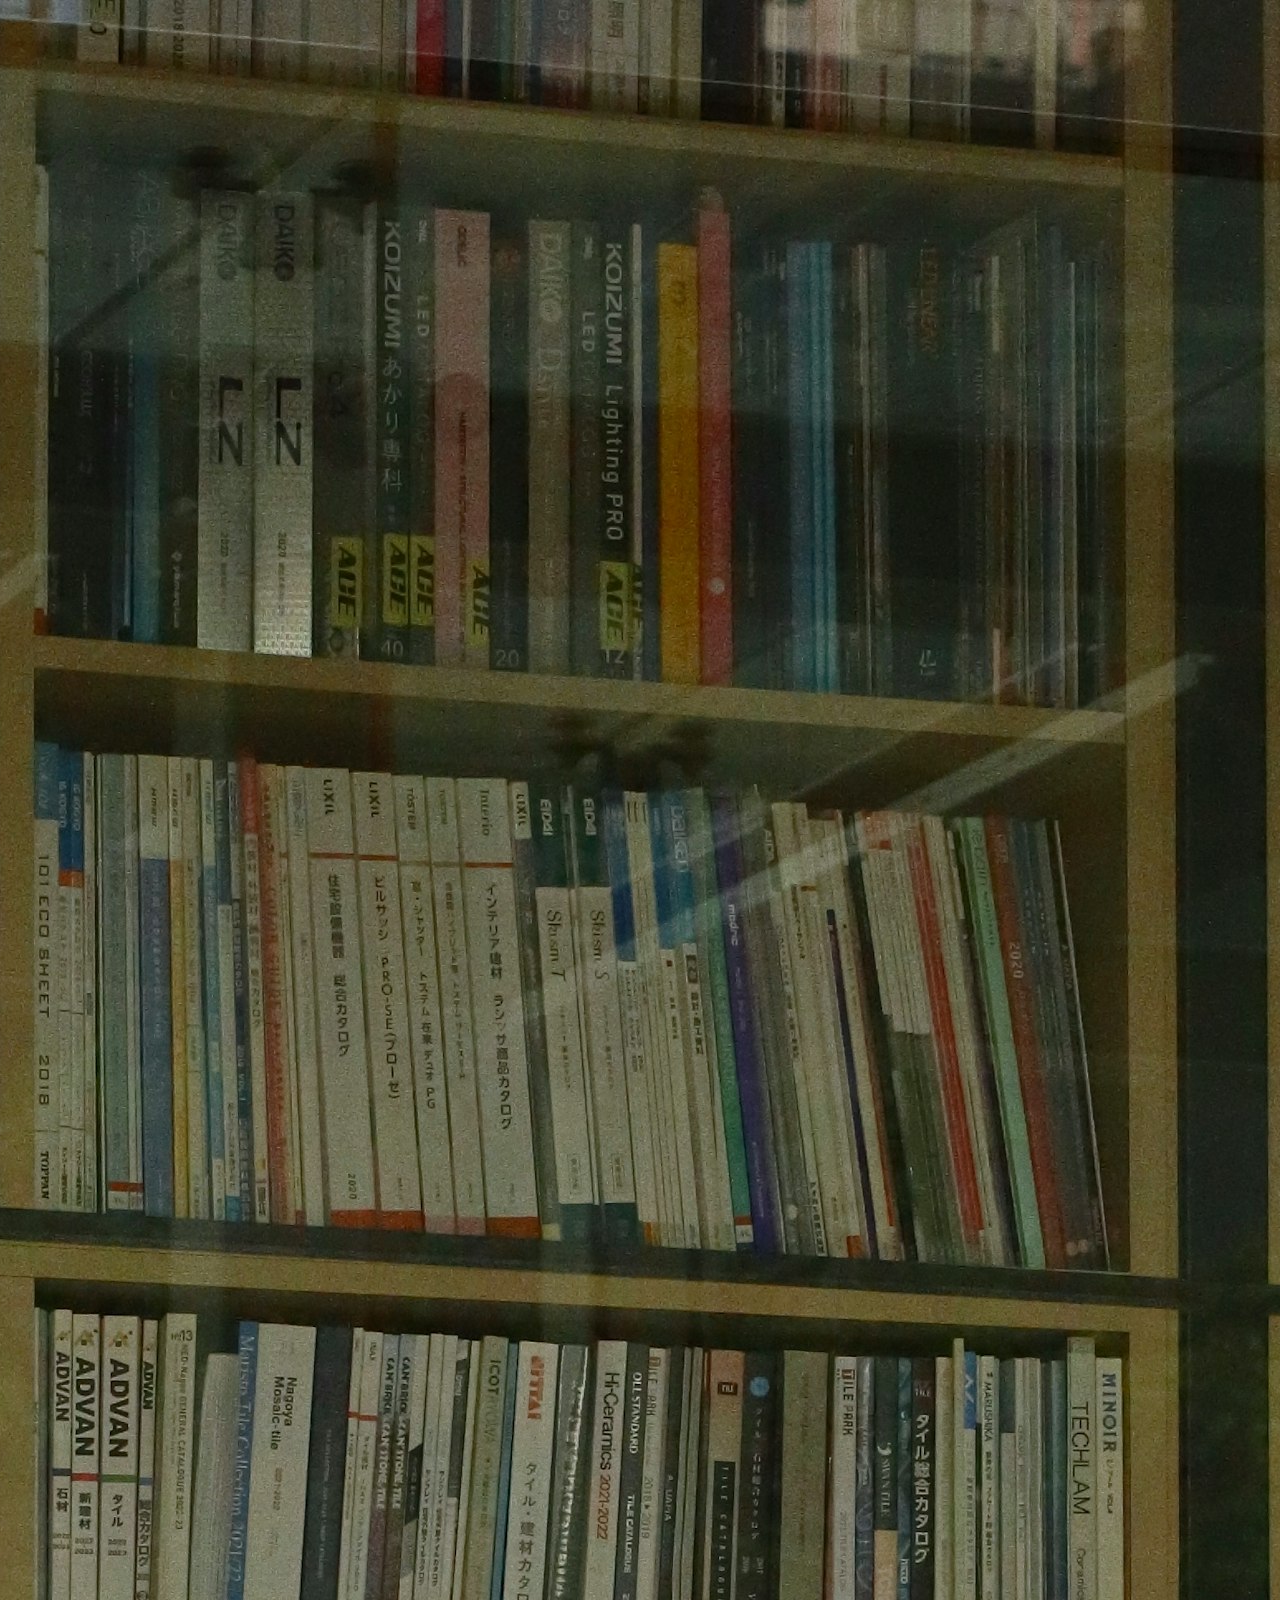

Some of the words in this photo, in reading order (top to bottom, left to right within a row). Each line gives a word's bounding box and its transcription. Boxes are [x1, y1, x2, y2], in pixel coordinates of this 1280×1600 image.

[383, 221, 402, 348] KOIZUMI
[602, 243, 623, 364] KOIZUMI
[601, 384, 623, 482] Lighting
[603, 493, 623, 541] PRO
[323, 779, 335, 816] LIXIL
[368, 781, 380, 818] LIXIL
[38, 895, 50, 939] ECO
[38, 948, 50, 1019] SHEET
[55, 1351, 70, 1423] ADVAN
[74, 1357, 96, 1457] ADVAN
[108, 1357, 130, 1459] ADVAN
[142, 1360, 154, 1411] ADVAN
[278, 1376, 292, 1428] Nagoya
[1096, 1373, 1114, 1453] MINOIR
[1066, 1403, 1087, 1517] TECHLAM
[110, 1493, 125, 1529] タイル
